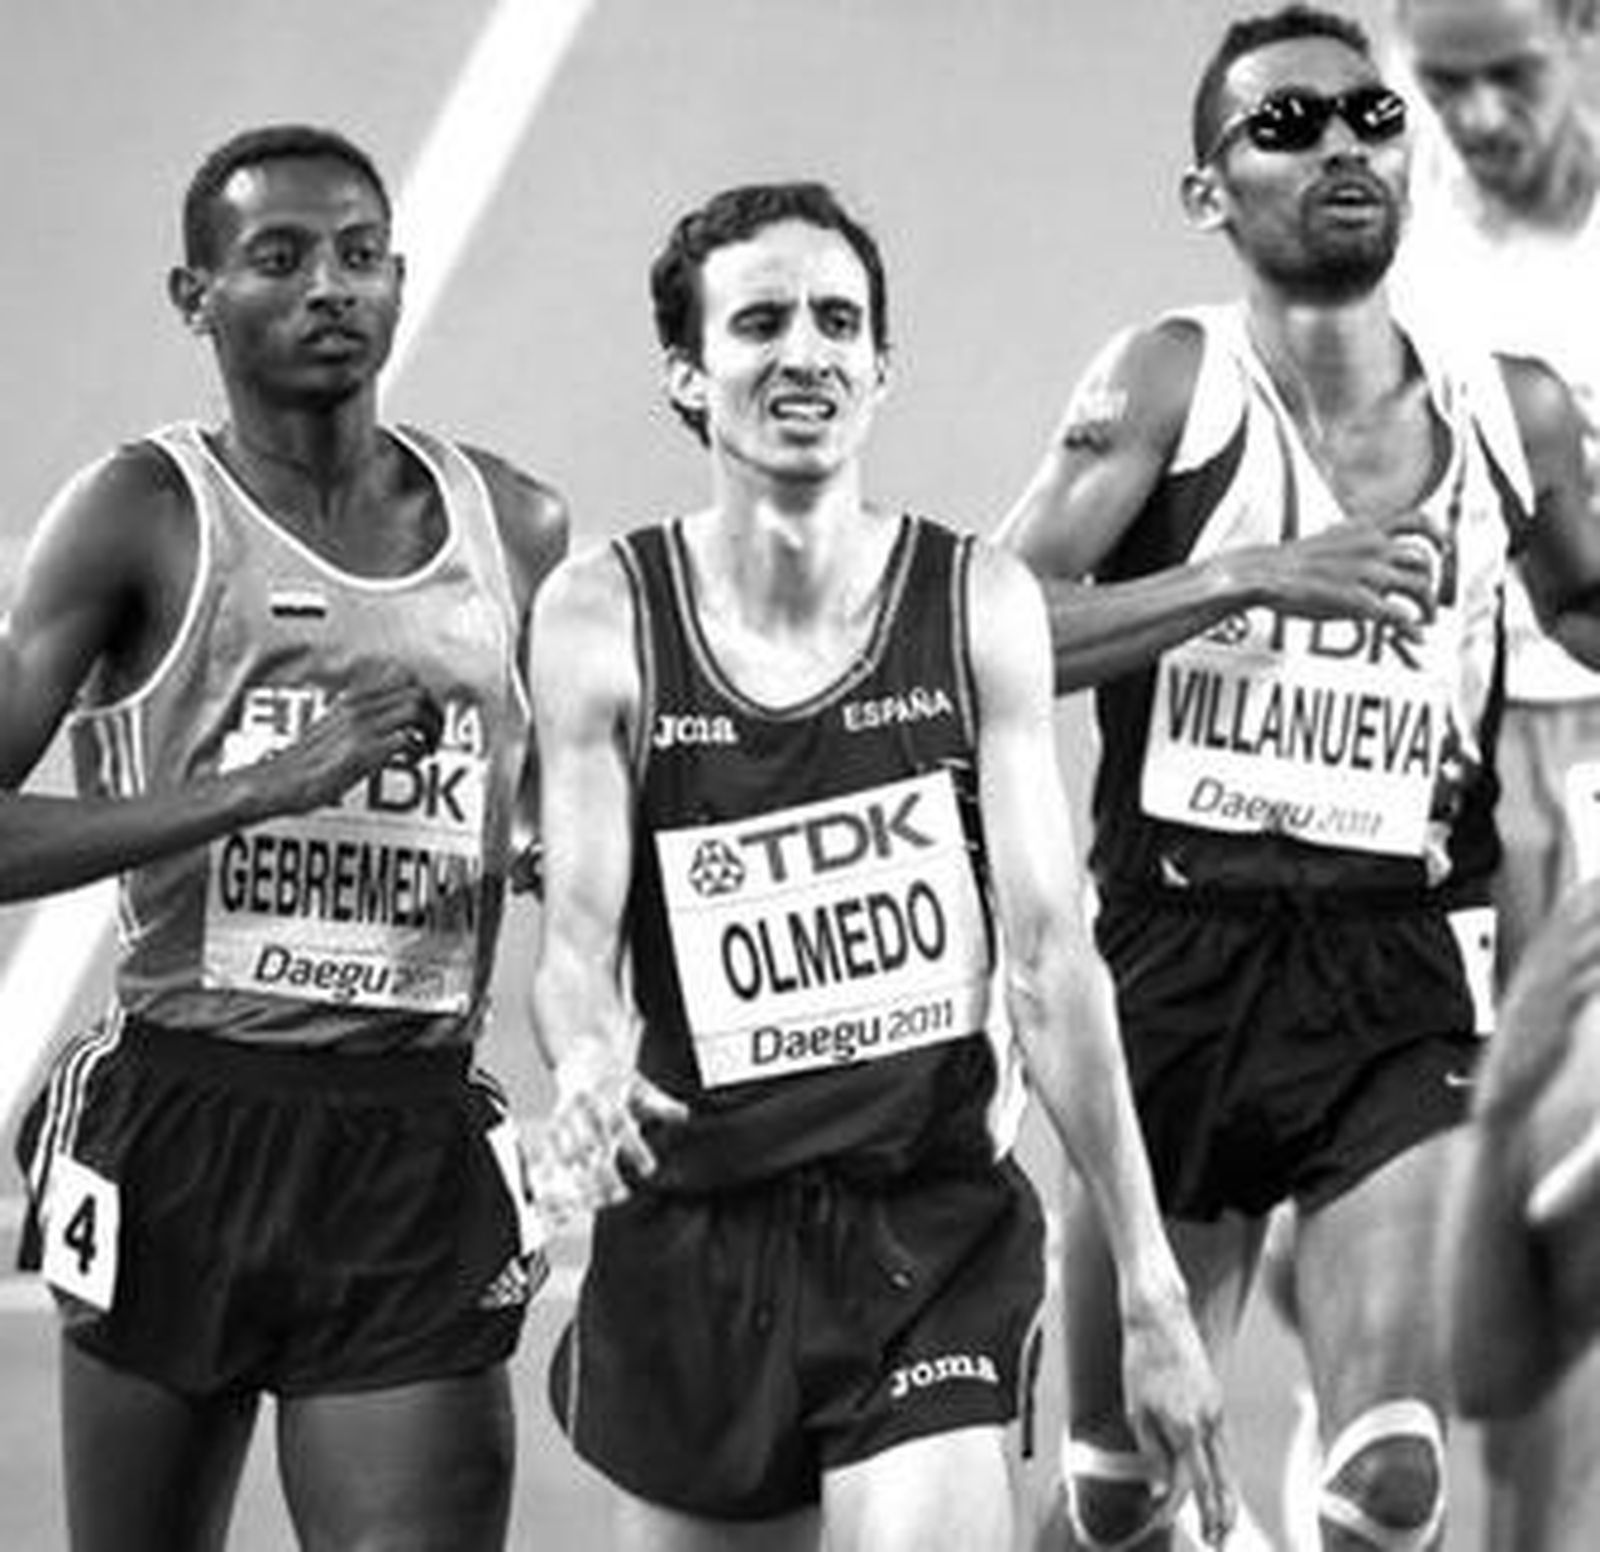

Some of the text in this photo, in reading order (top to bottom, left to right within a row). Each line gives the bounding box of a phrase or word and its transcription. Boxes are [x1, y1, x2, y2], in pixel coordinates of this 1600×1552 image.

[842, 686, 954, 733] ESPAÑA
[1168, 665, 1432, 778] VILLANUEVA
[367, 762, 466, 823] DK
[738, 792, 936, 882] TDK
[219, 834, 476, 934] GEBREMED
[254, 944, 390, 999] Daegu
[721, 879, 947, 1001] OLMEDO
[751, 999, 955, 1062] Daegu 2011
[64, 1193, 97, 1275] 4
